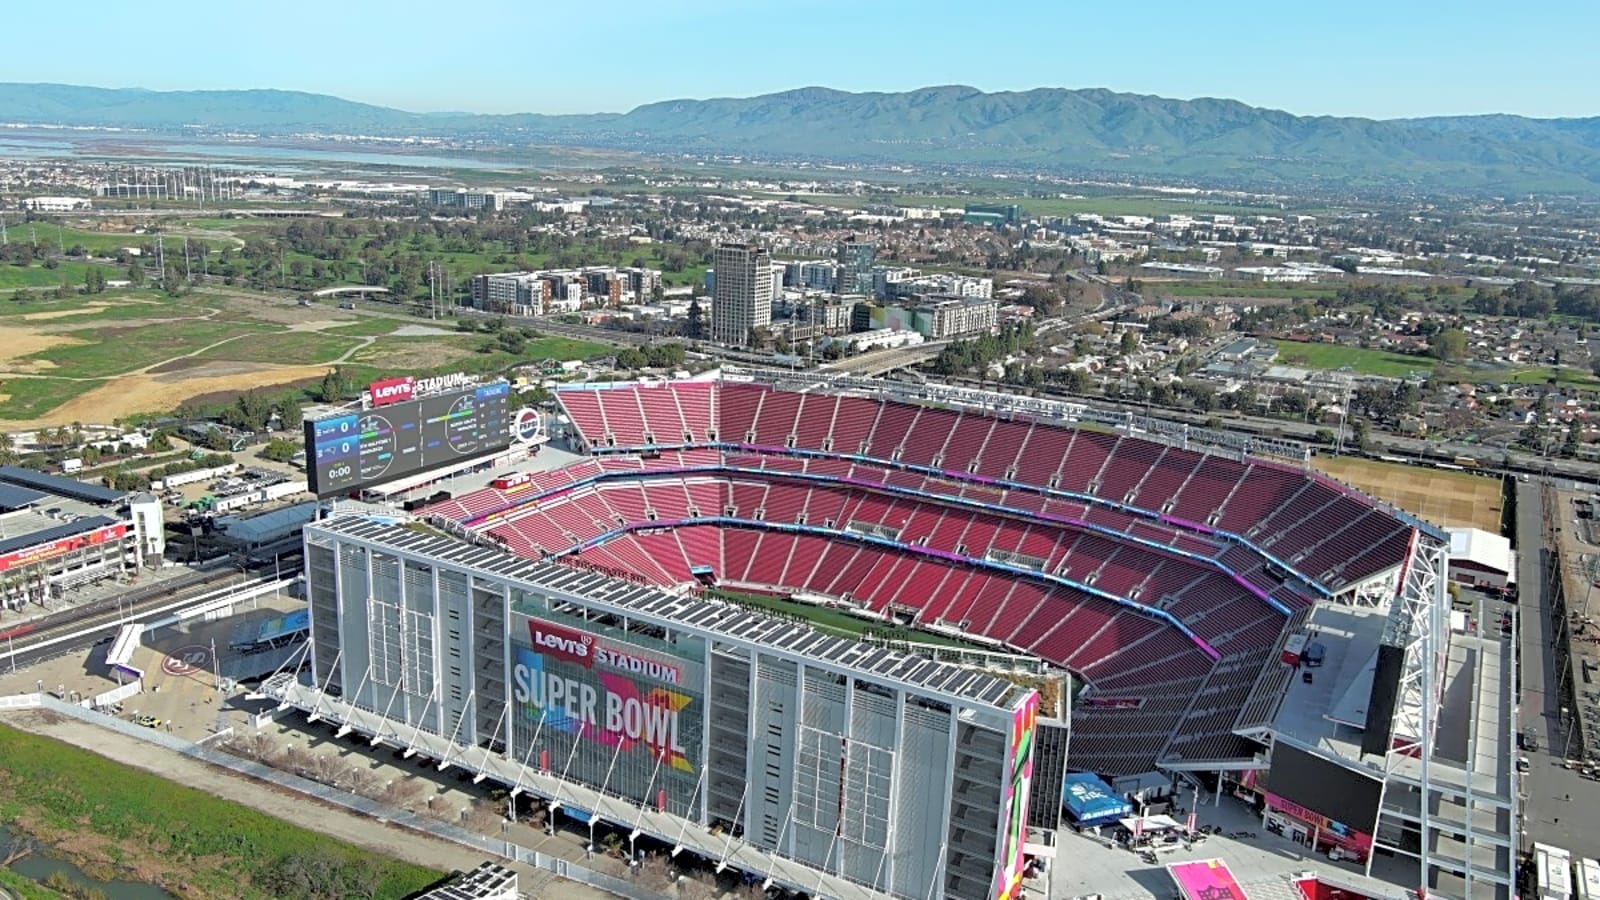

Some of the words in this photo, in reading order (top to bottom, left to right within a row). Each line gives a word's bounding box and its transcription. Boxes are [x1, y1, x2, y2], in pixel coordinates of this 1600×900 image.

[416, 372, 465, 392] STADIUM
[341, 422, 349, 433] 0
[342, 442, 350, 453] 0
[328, 465, 351, 479] 0:00
[535, 631, 588, 657] Levi's
[596, 650, 678, 683] STADIUM
[514, 663, 597, 726] SUPER
[606, 691, 686, 754] BOWL
[1280, 799, 1303, 817] SUPER
[1305, 811, 1324, 826] BOWL
